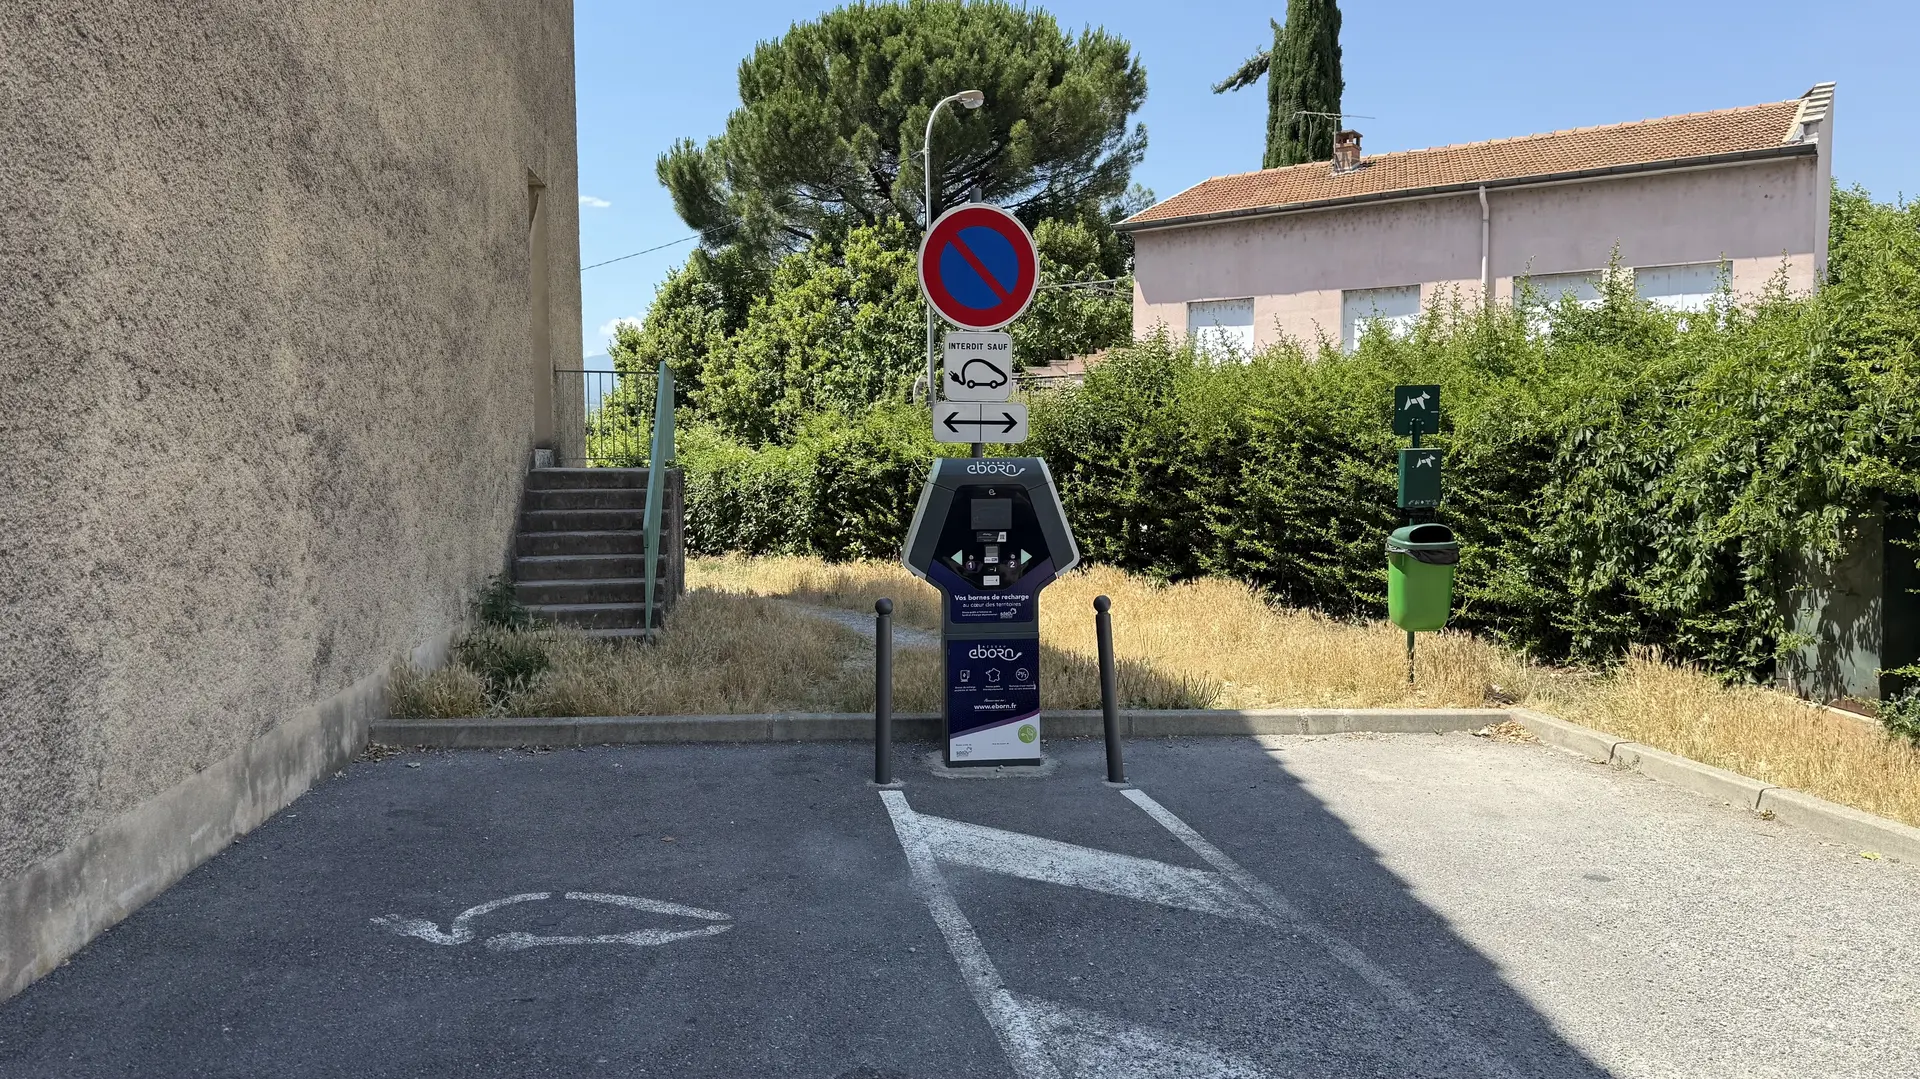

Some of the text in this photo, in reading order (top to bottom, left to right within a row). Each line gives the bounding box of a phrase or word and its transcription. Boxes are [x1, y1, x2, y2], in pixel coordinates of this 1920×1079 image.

[948, 342, 1009, 351] INTERDIT SAUF
[966, 461, 1026, 477] eborn
[1001, 594, 1029, 602] recharge
[968, 644, 1023, 661] eborn
[973, 702, 1017, 710] www.eborn.fr
